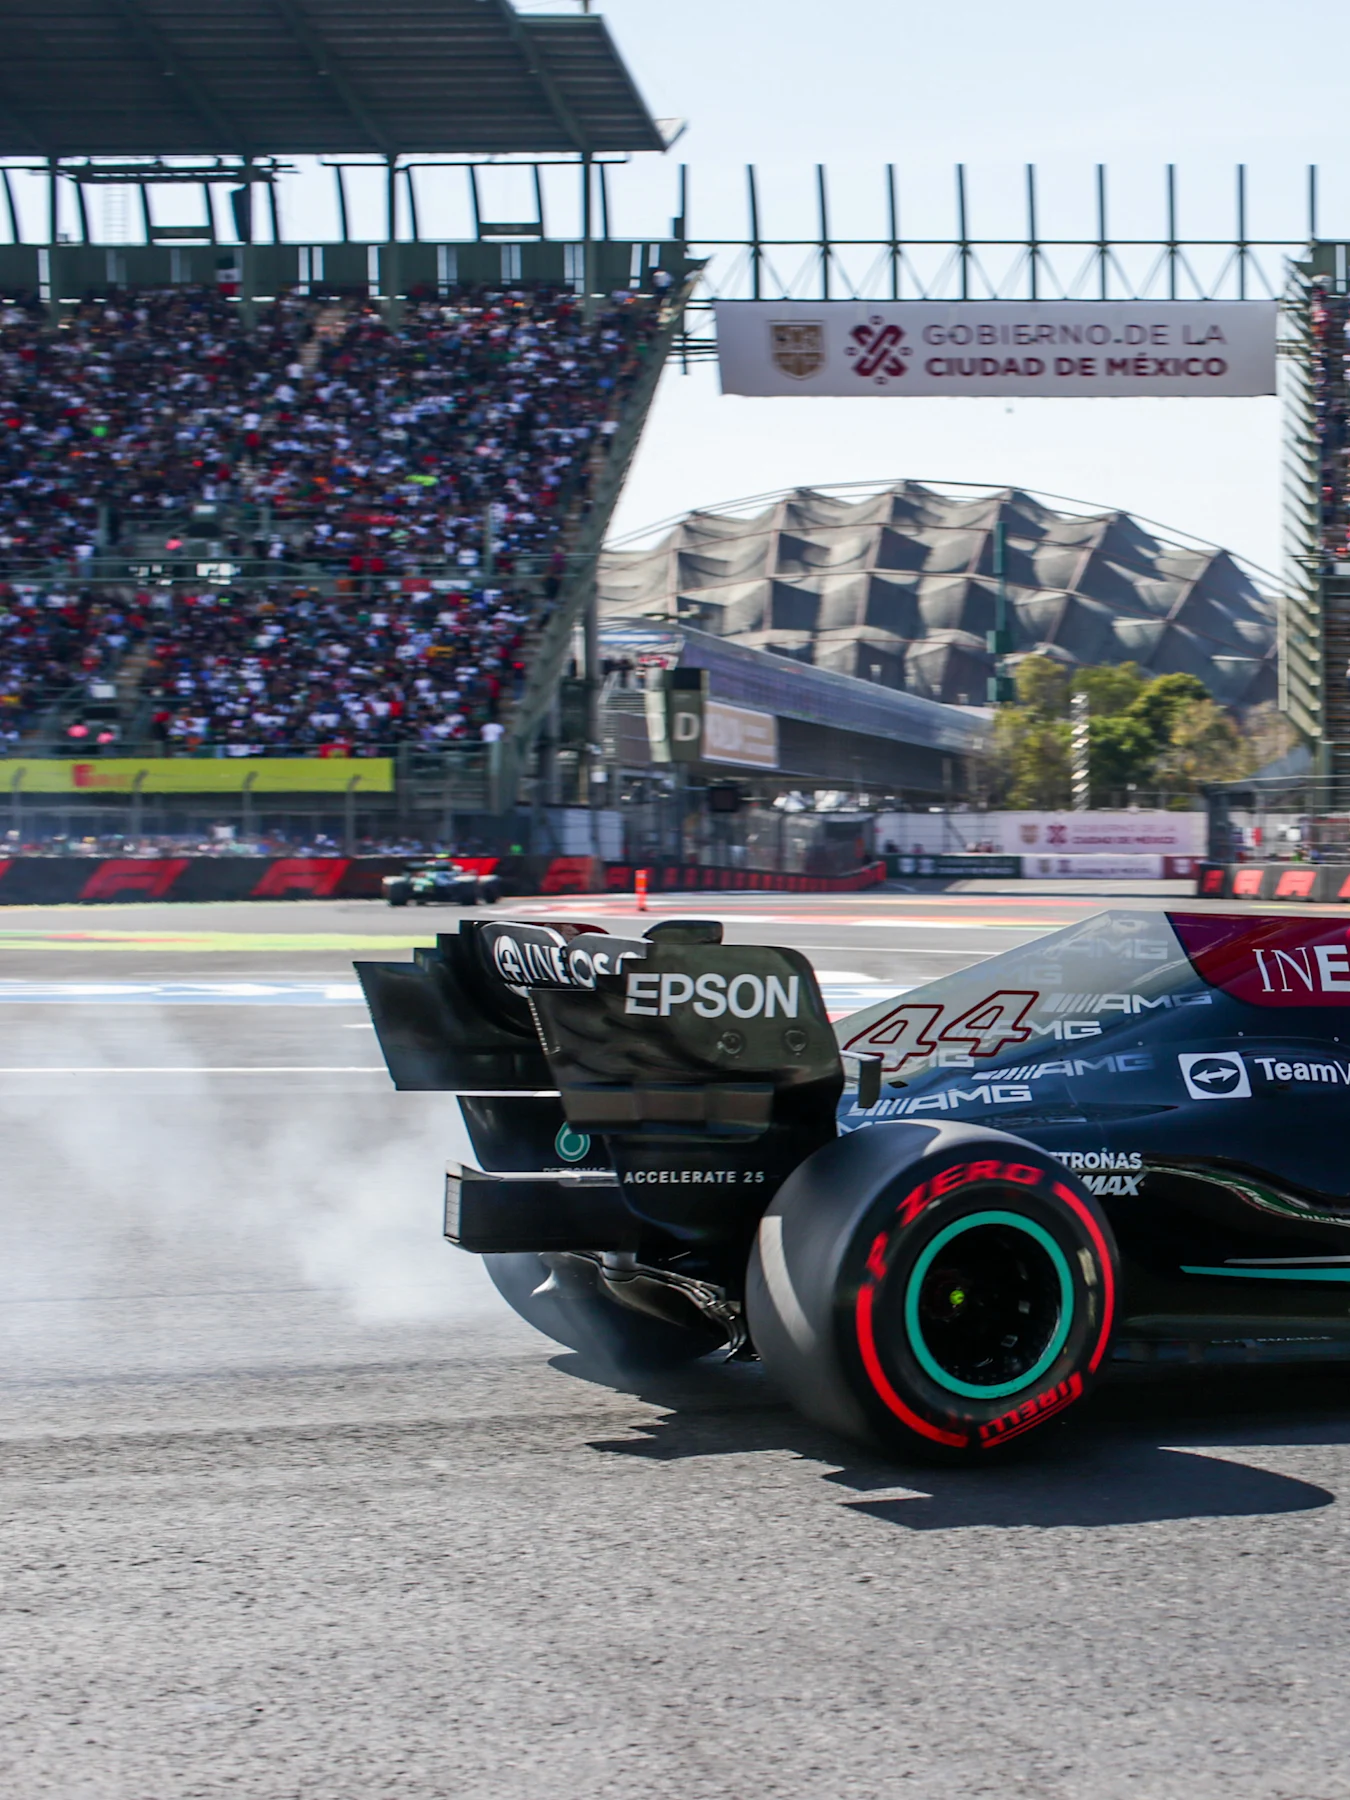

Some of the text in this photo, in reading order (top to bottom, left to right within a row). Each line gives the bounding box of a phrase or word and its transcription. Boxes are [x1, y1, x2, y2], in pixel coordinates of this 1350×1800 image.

[922, 324, 1228, 346] GOBIERNO DE LA
[924, 352, 1229, 377] CIUDAD DE MÉXICO
[673, 711, 700, 742] D
[624, 972, 799, 1019] EPSON
[1092, 991, 1213, 1015] AMG
[845, 989, 1040, 1073] 44
[1034, 1053, 1155, 1080] AMG
[906, 1083, 1033, 1115] AMG
[623, 1170, 765, 1184] ACCELERATE 25
[896, 1159, 1046, 1228] ZERO
